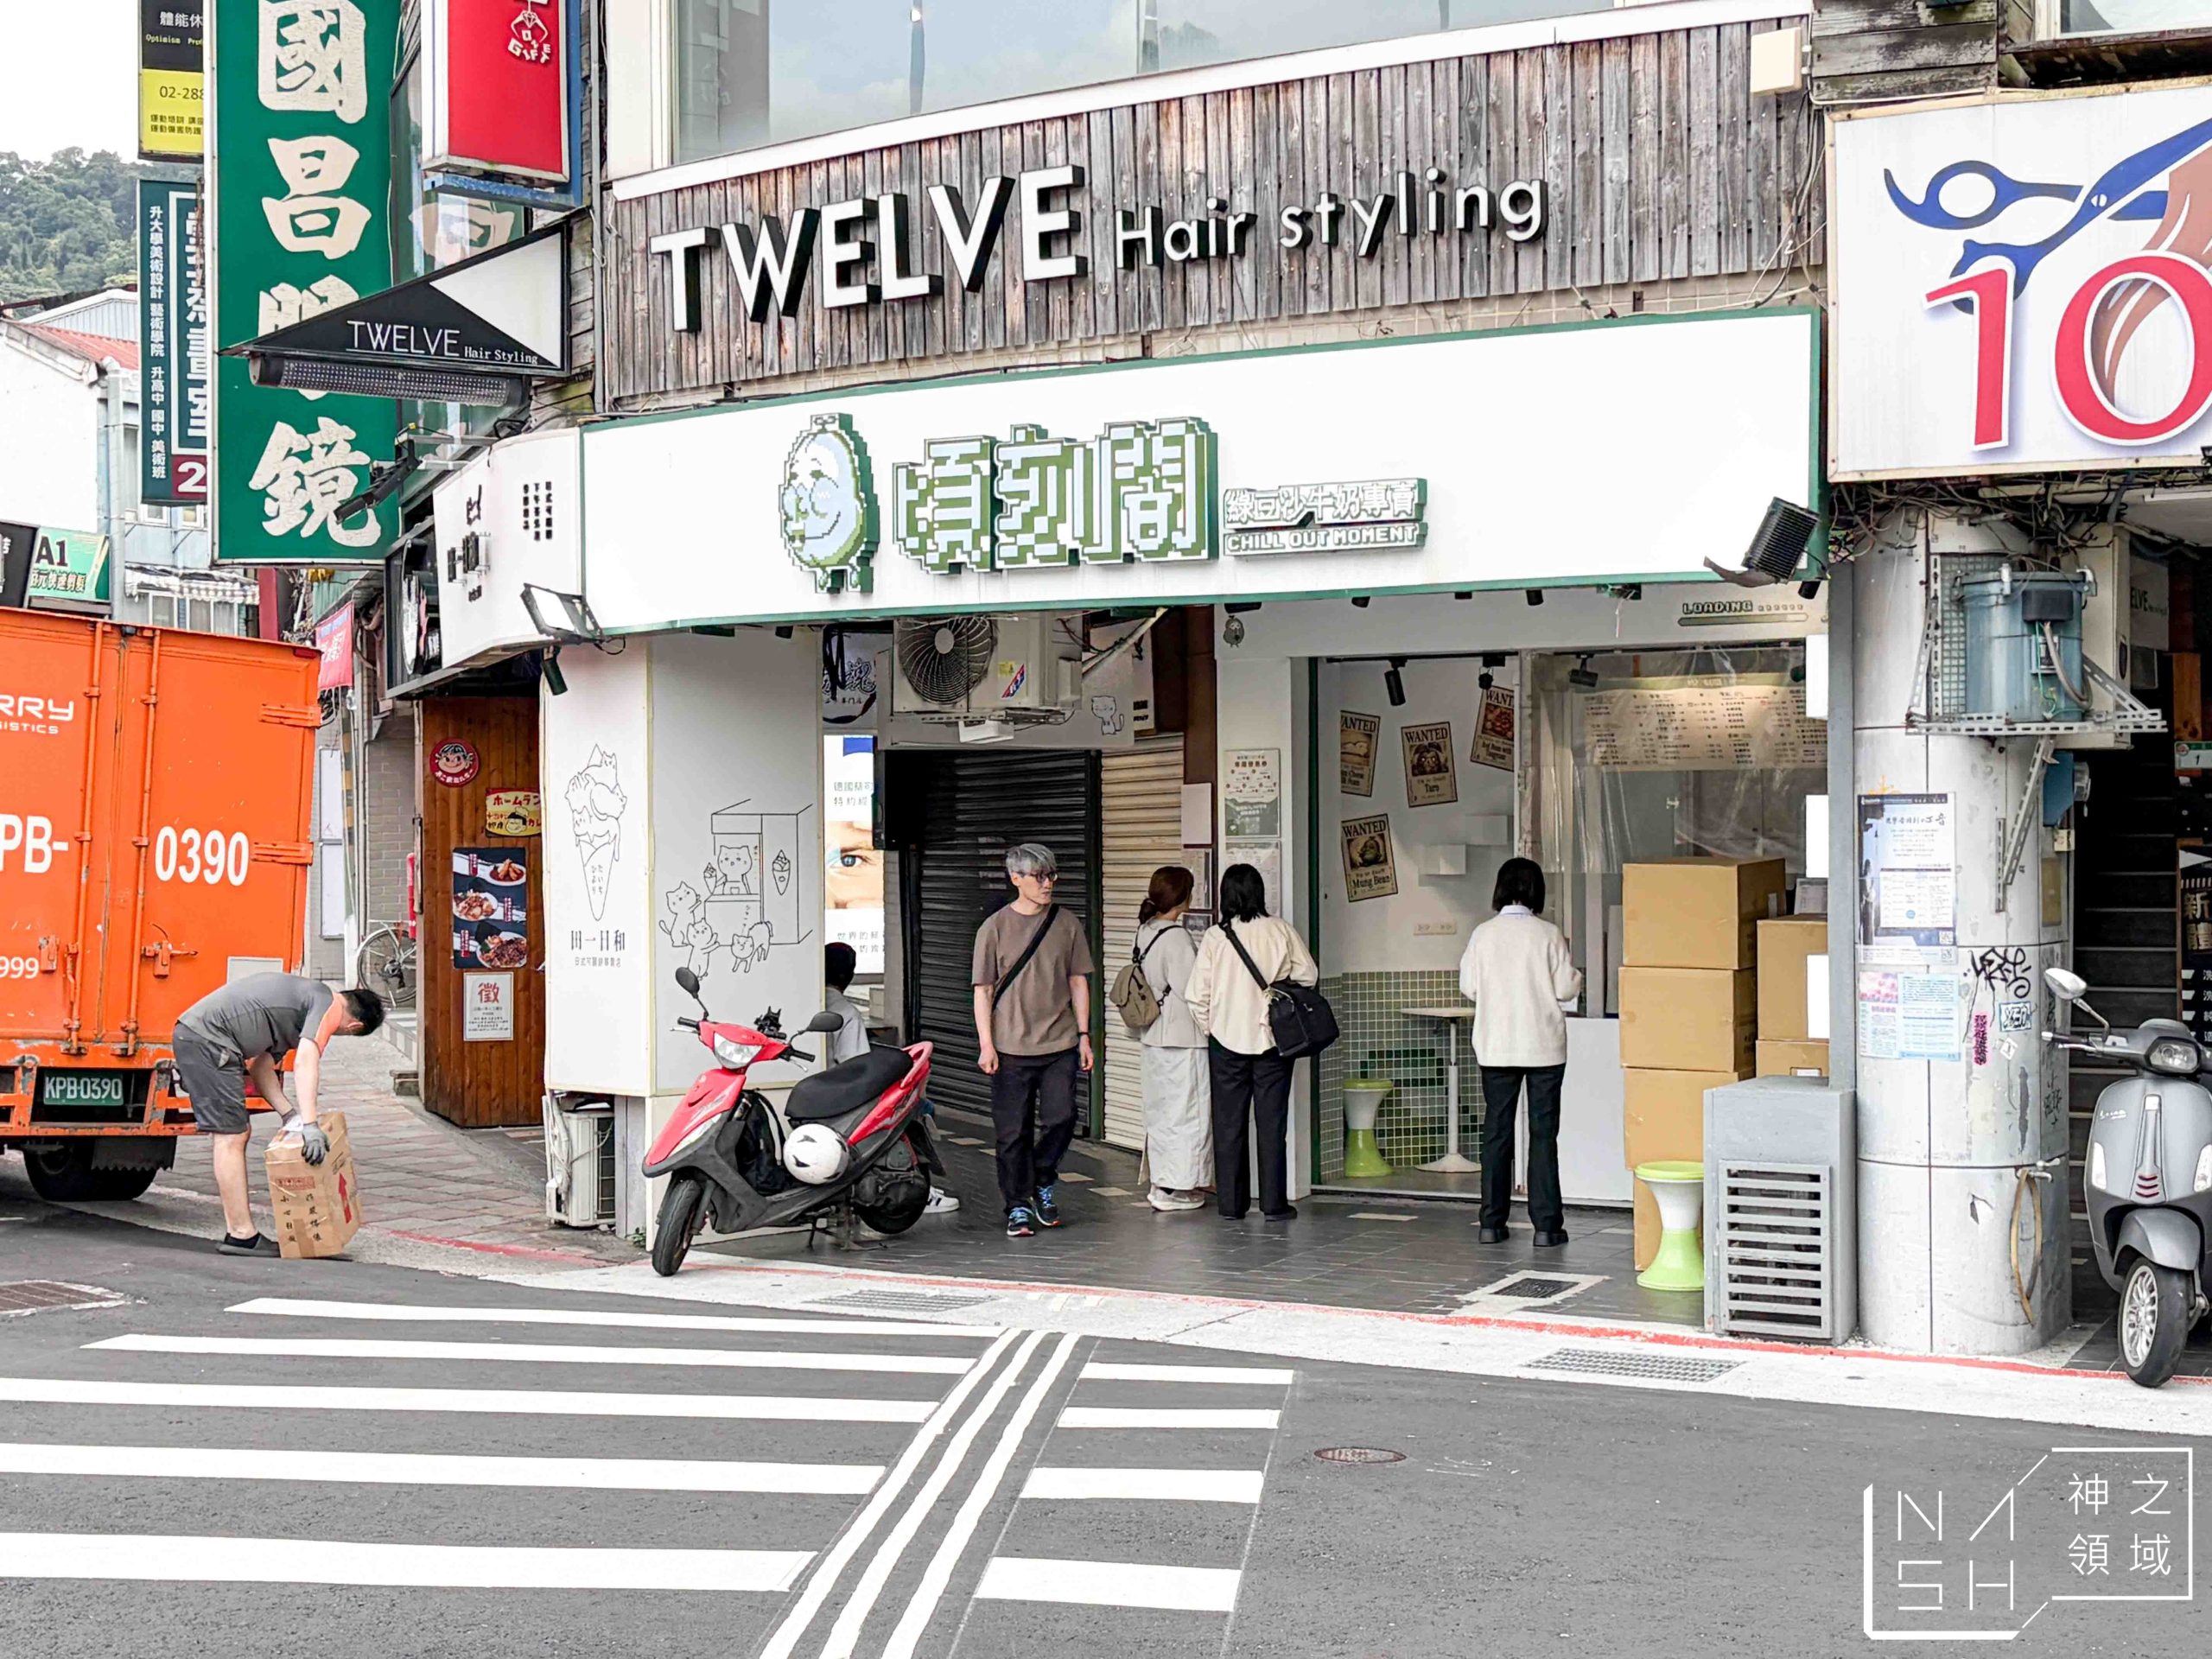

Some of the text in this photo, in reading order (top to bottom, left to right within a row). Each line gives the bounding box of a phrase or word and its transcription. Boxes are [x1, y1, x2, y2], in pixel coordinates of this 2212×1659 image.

[651, 164, 1550, 334] TWELVE Hair styling
[346, 320, 539, 366] TWELVE Hair Styling
[1225, 481, 1417, 525] 綠豆沙牛奶專賣
[1226, 525, 1418, 552] CHILL OUT MOMENT
[35, 535, 68, 568] A1
[1682, 600, 1753, 614] LOADING
[0, 721, 59, 734] ISTICS
[1404, 728, 1448, 744] WANTED
[1342, 819, 1386, 838] WANTED
[155, 826, 250, 887] 0390
[0, 956, 40, 979] 999
[45, 1077, 123, 1100] KPB-0390
